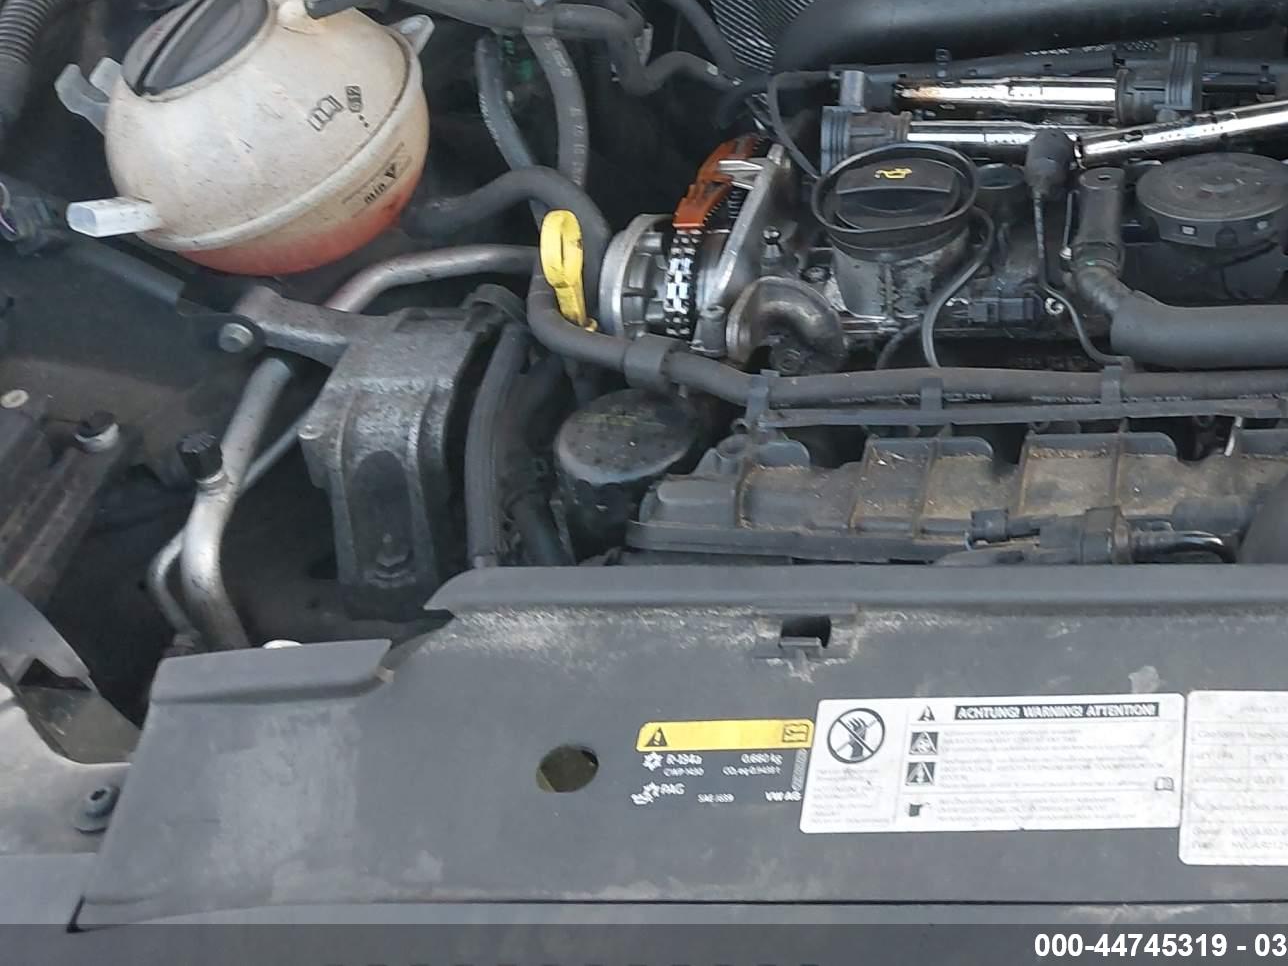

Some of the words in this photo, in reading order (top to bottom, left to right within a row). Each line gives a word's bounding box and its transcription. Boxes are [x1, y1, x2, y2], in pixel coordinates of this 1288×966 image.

[958, 706, 1020, 718] ACHTUNG!
[1023, 705, 1083, 718] WARNING!
[1086, 704, 1155, 716] ATTENTION!
